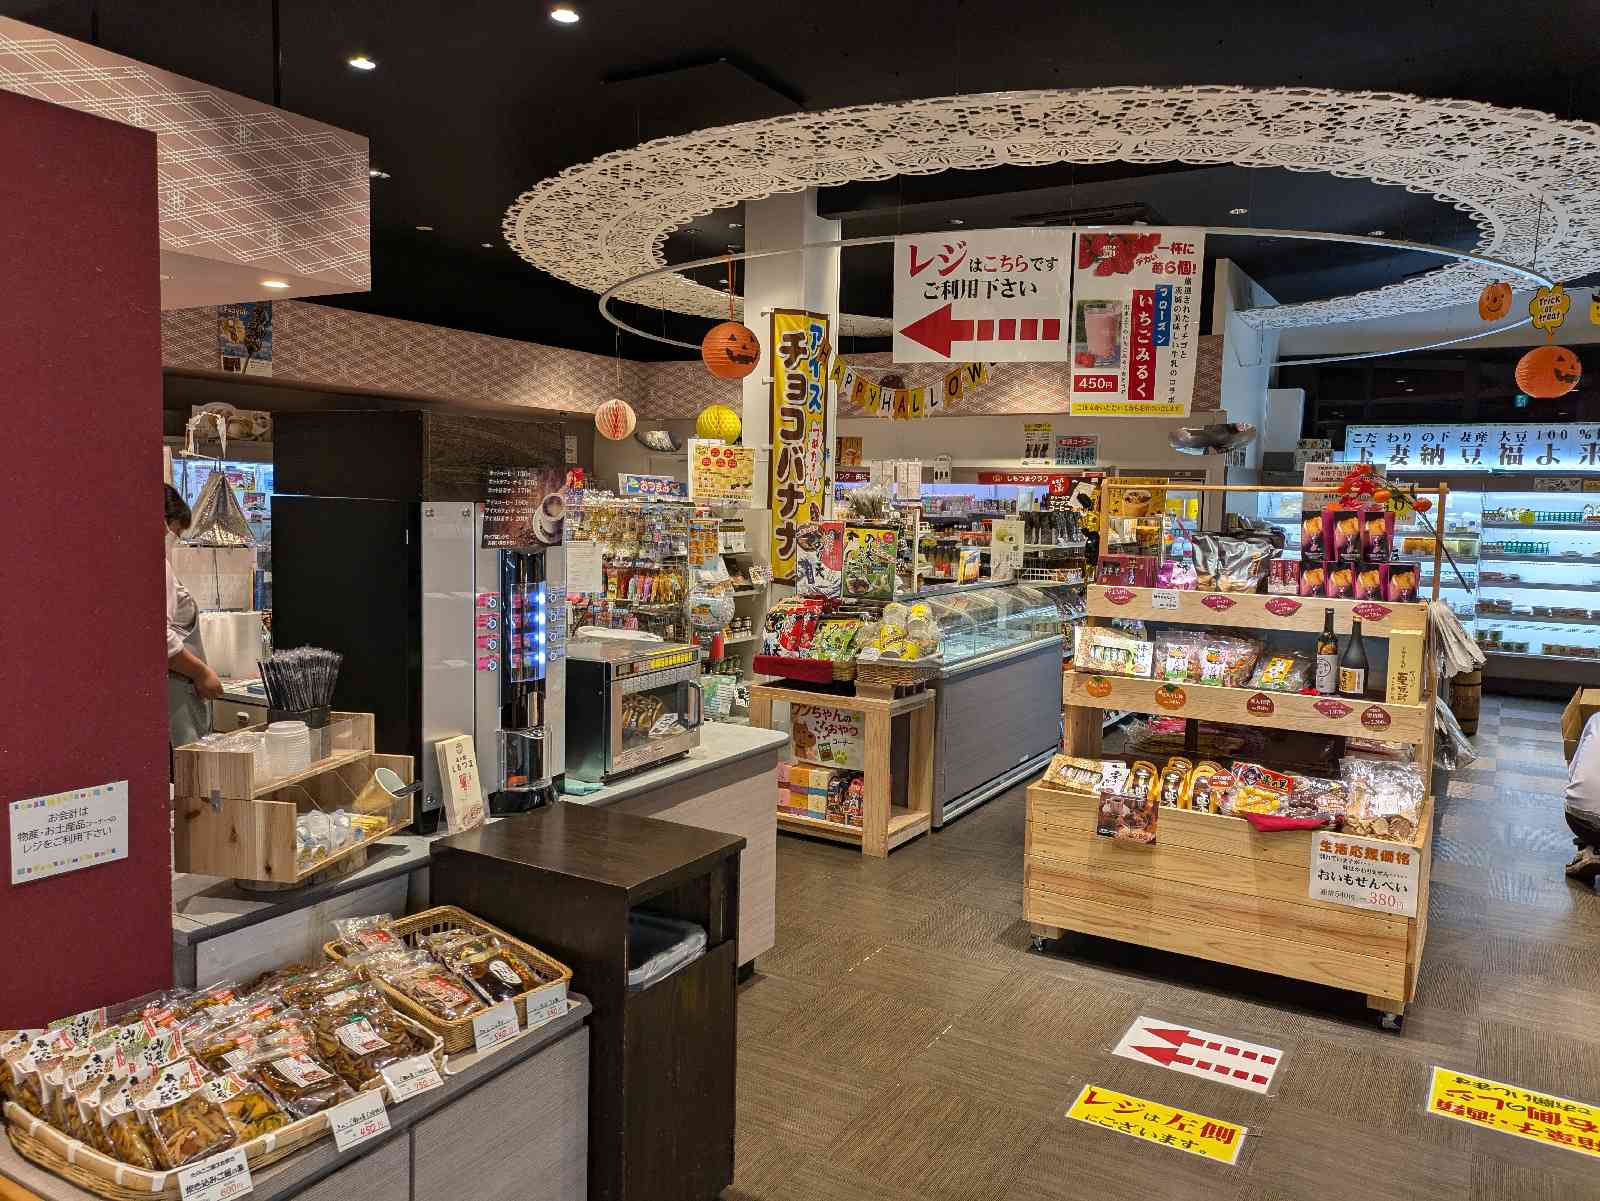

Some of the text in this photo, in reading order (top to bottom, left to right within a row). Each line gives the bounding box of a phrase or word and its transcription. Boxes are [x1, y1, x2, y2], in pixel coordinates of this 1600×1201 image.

[908, 239, 1060, 278] レジはこちらです
[922, 278, 1038, 300] ご利用下さい
[1156, 286, 1170, 344] フローズン
[1135, 294, 1153, 398] いちごみるく
[808, 323, 824, 414] アイス
[1078, 377, 1113, 390] 450円
[776, 331, 810, 561] チョコバナナ
[48, 806, 89, 823] お会計は
[23, 827, 112, 854] レジをご利用下さい
[1319, 839, 1410, 866] 生活応援価格
[1317, 868, 1408, 893] おいもせんべい
[1083, 1090, 1235, 1145] レジは左側
[1084, 1113, 1207, 1156] にございます。
